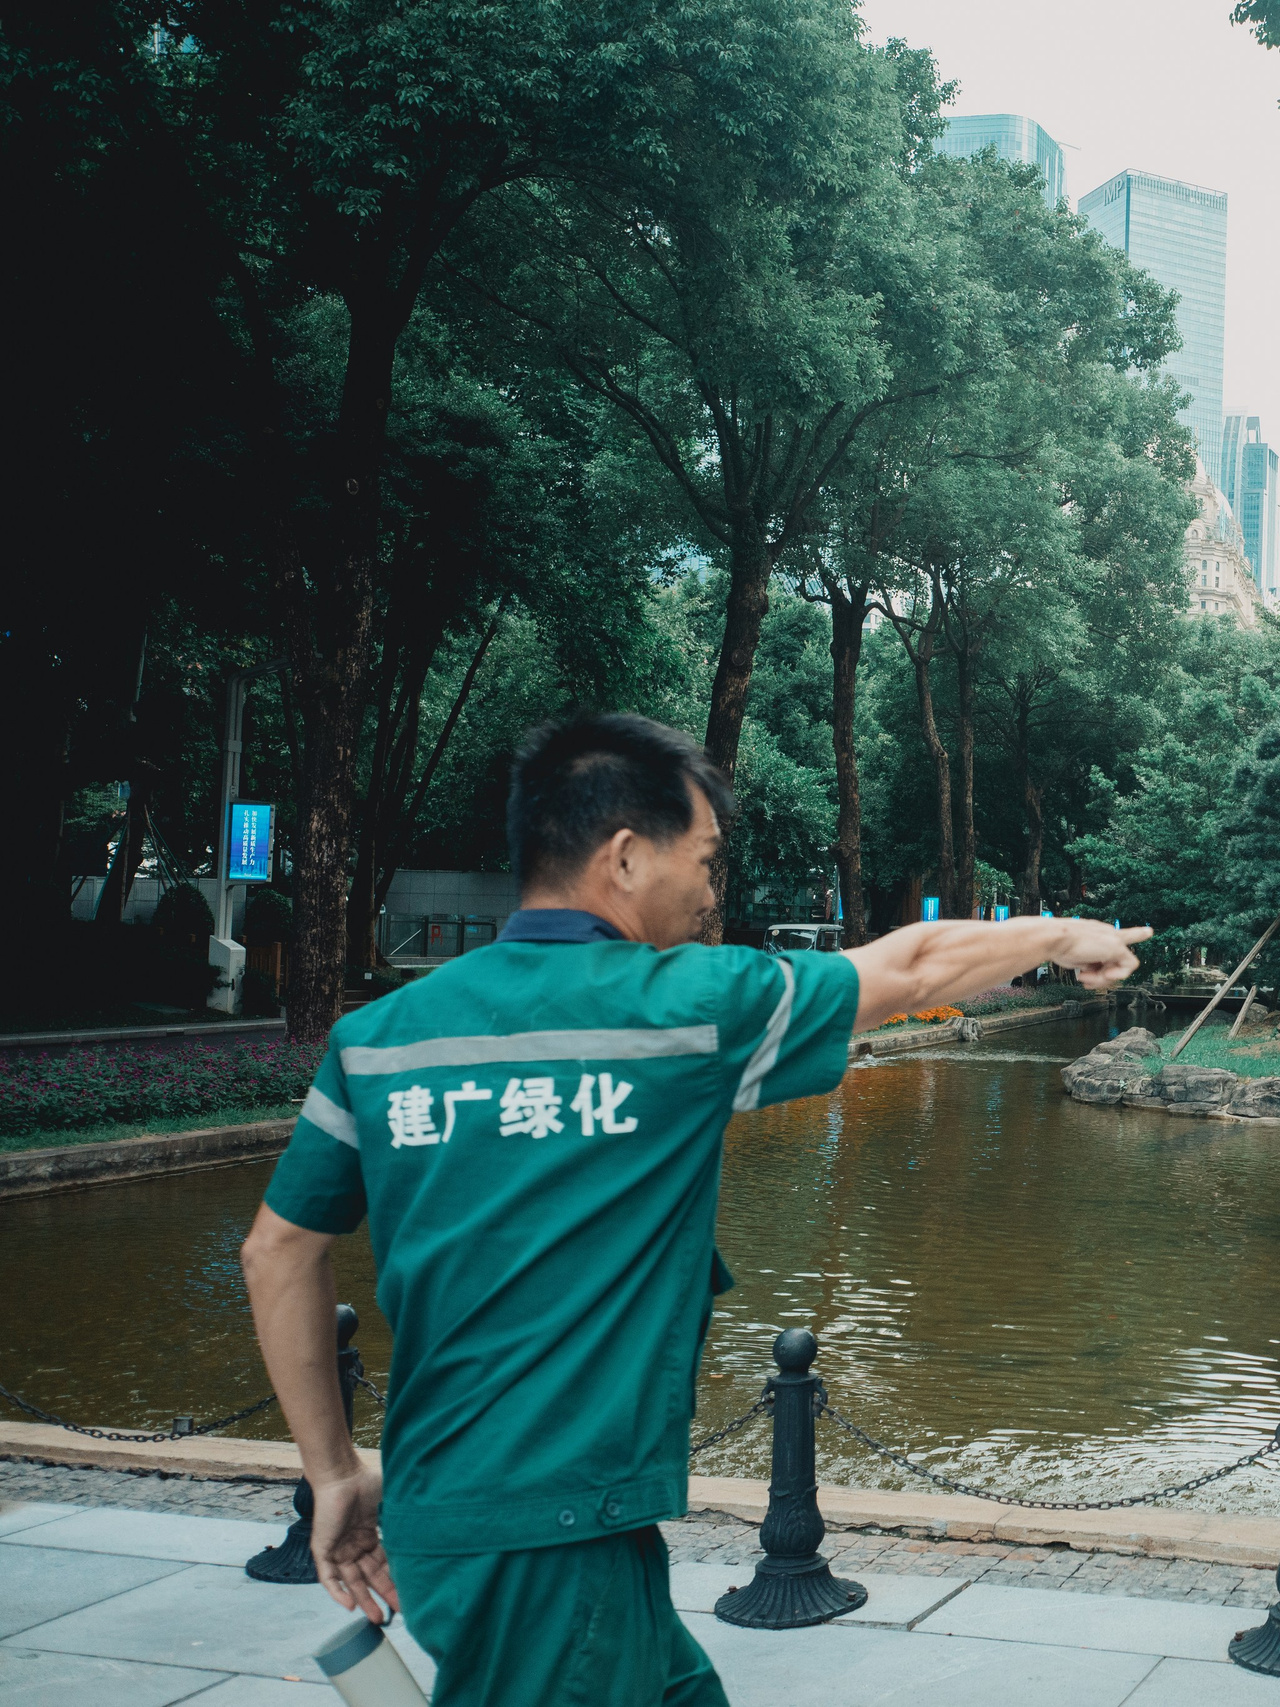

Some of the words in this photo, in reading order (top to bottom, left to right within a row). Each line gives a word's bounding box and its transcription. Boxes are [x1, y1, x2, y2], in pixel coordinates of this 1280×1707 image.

[1103, 178, 1123, 207] IMP
[386, 1072, 639, 1150] 建广绿化
